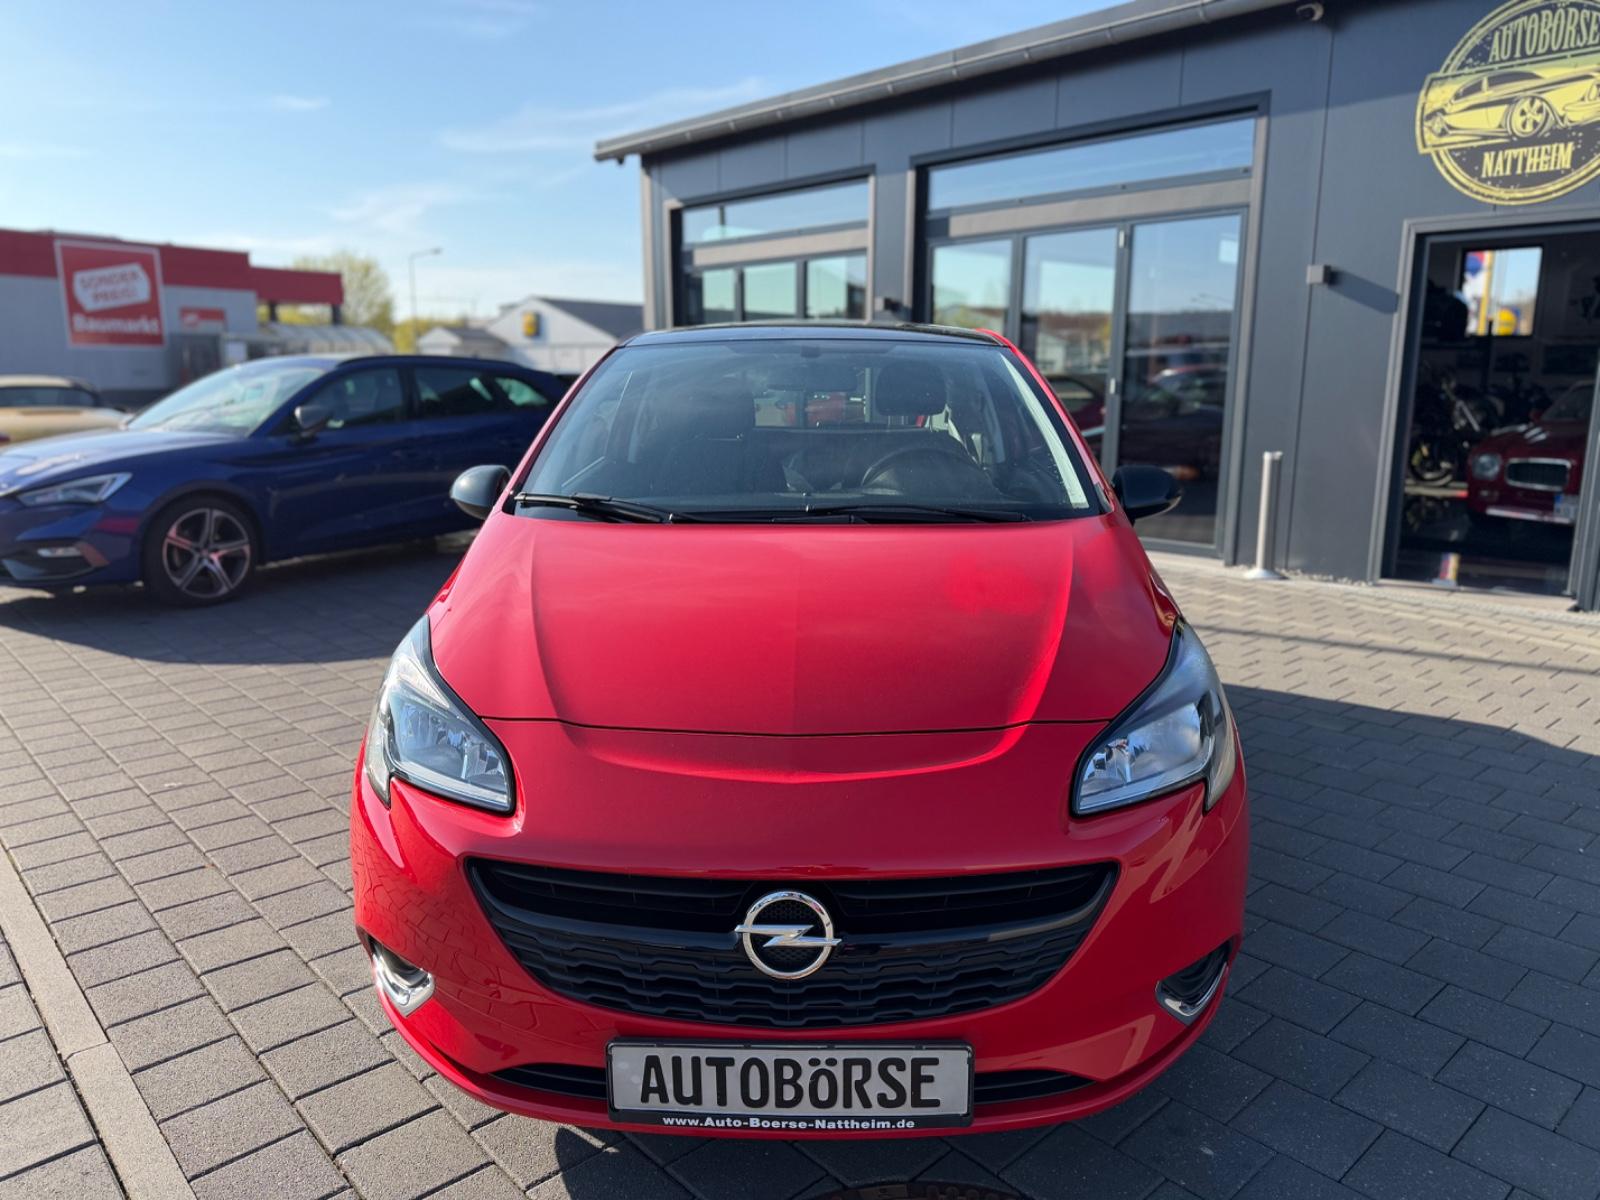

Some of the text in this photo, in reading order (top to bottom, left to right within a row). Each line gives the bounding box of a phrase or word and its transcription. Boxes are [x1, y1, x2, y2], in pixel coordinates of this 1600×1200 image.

[1481, 142, 1574, 178] NATTHEIM
[73, 313, 159, 335] Baumarkt
[662, 1116, 916, 1129] www.Auto-Boerse-Nattheim.de
